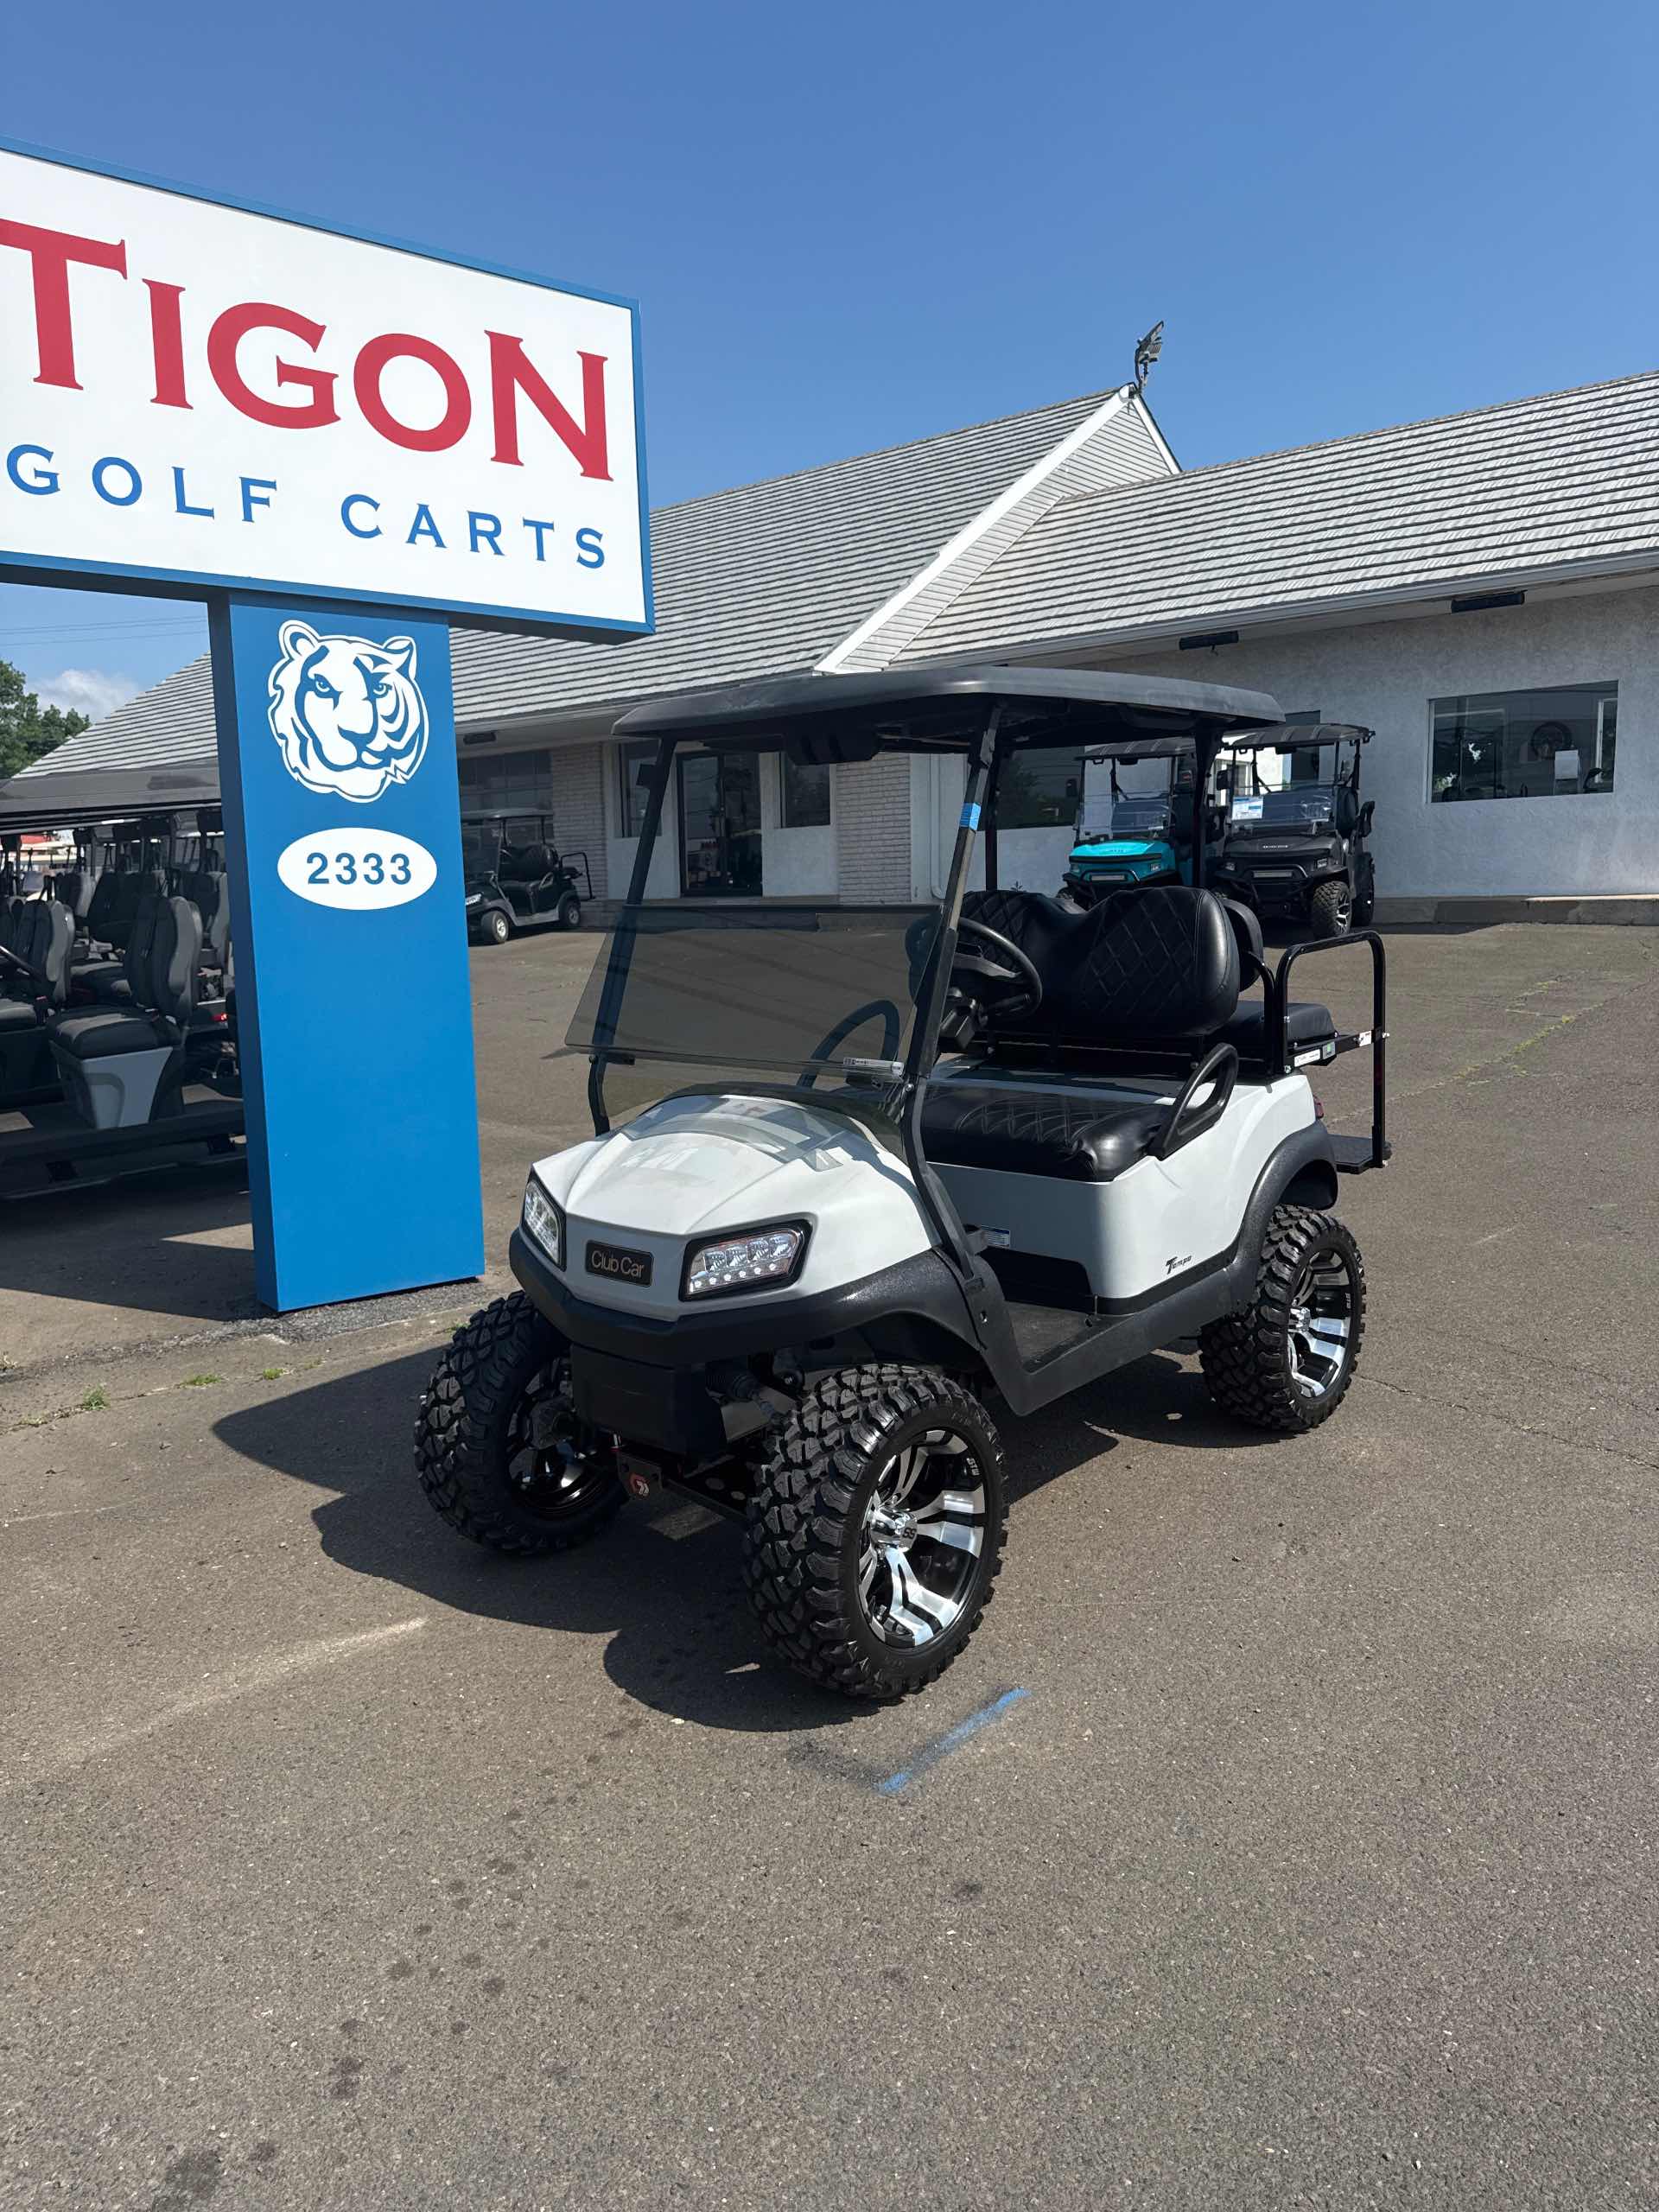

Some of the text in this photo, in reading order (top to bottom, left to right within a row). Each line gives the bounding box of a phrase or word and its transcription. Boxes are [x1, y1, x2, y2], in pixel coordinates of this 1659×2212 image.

[0, 219, 613, 481] TIGON
[6, 444, 605, 568] GOLF CARTS
[307, 852, 411, 885] 2333
[591, 1250, 645, 1278] Club Car
